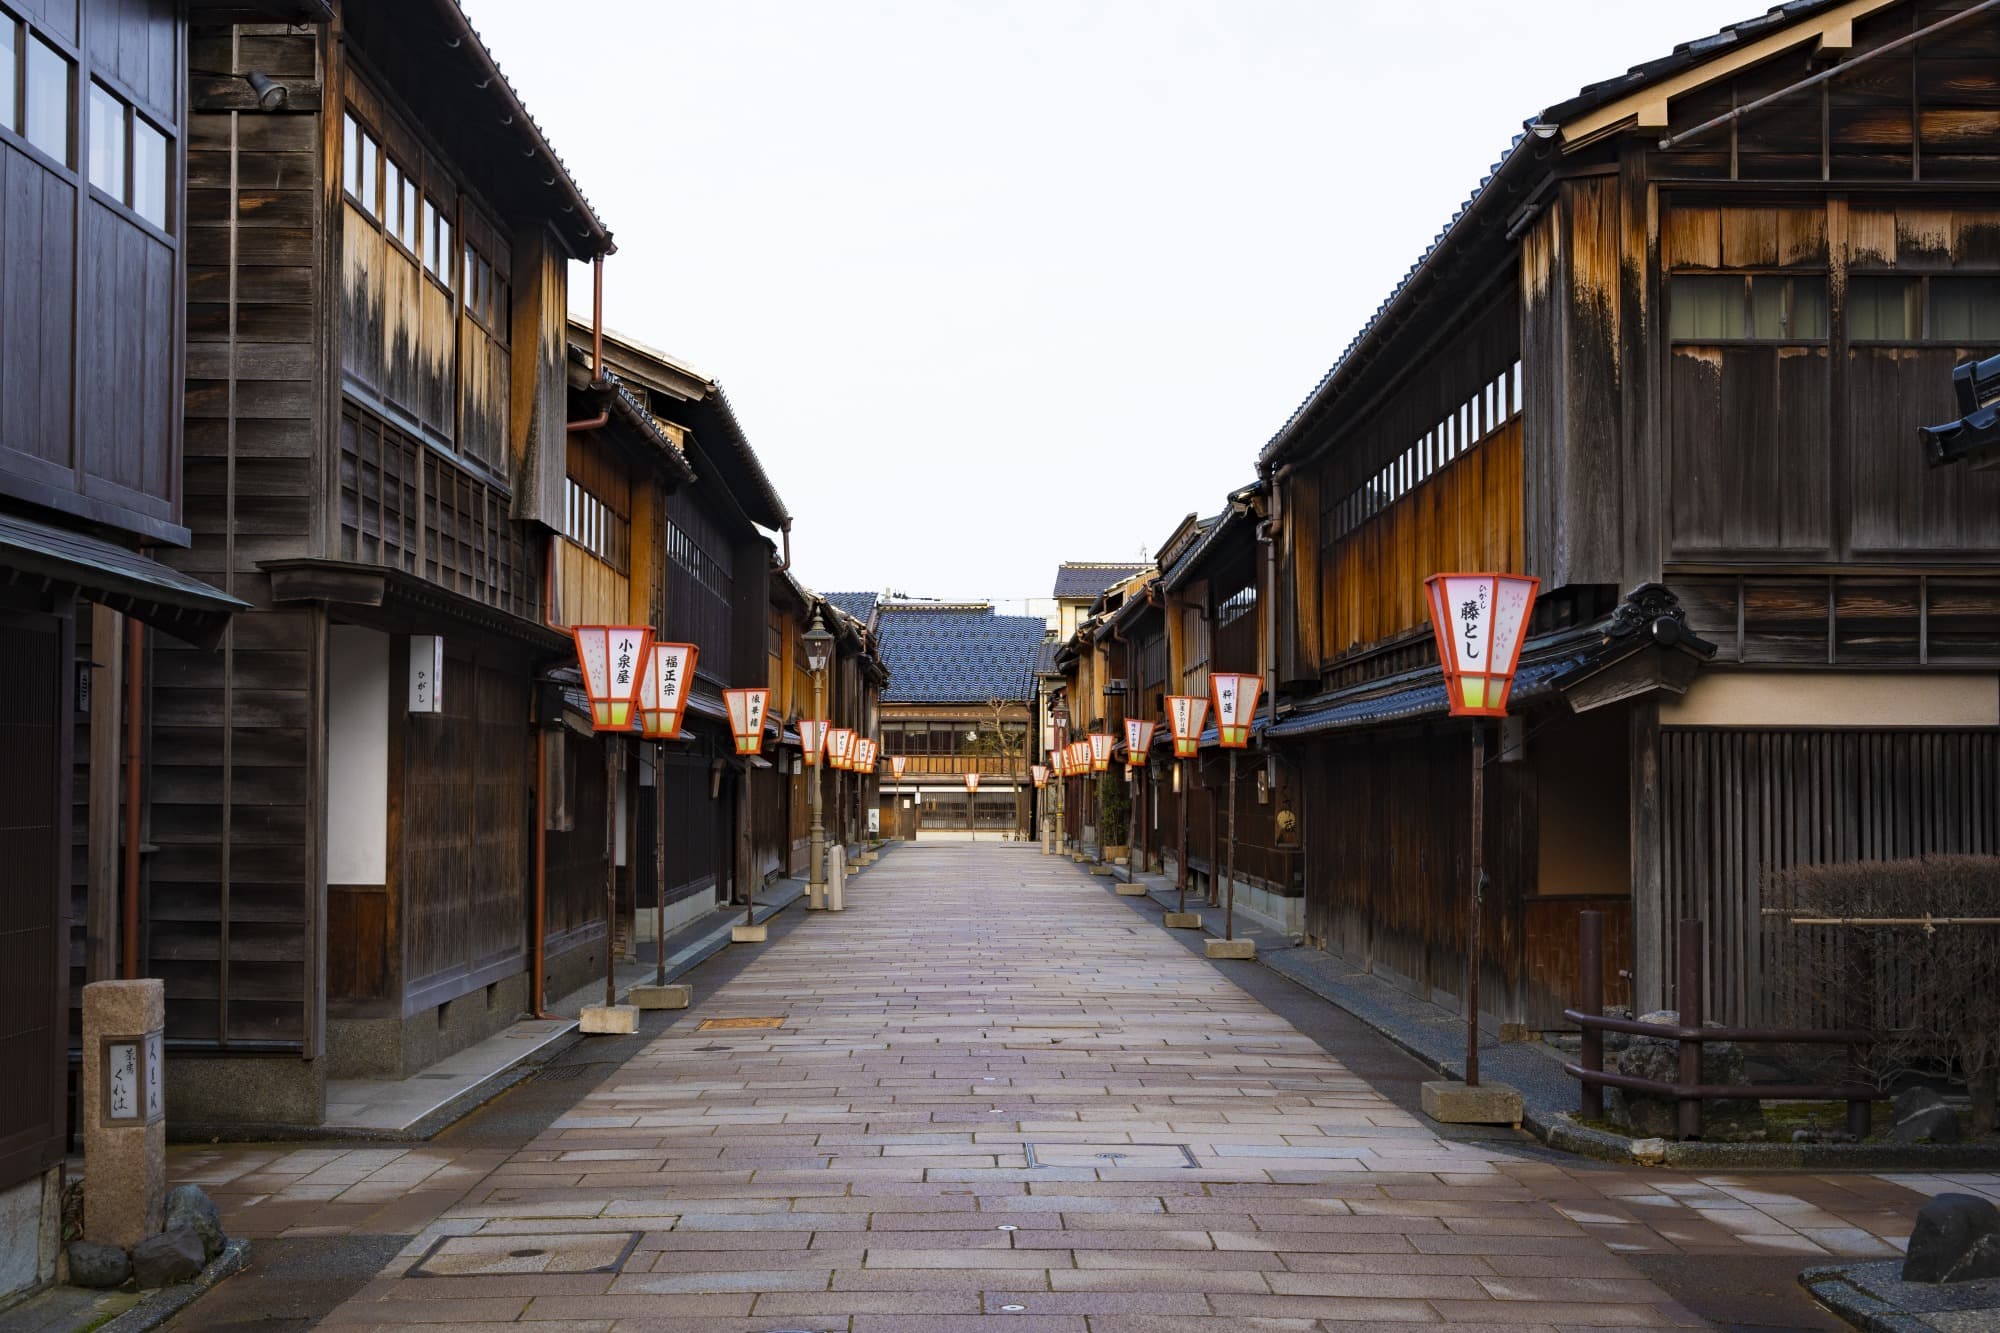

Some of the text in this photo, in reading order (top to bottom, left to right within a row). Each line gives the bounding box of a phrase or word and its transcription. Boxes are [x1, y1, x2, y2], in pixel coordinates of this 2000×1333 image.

[1479, 584, 1487, 609] ひがし
[1461, 600, 1480, 659] 藤とし
[617, 638, 633, 684] 小泉屋
[664, 655, 678, 696] 福正宗
[417, 671, 426, 703] ひがし
[113, 1068, 128, 1111] くれは
